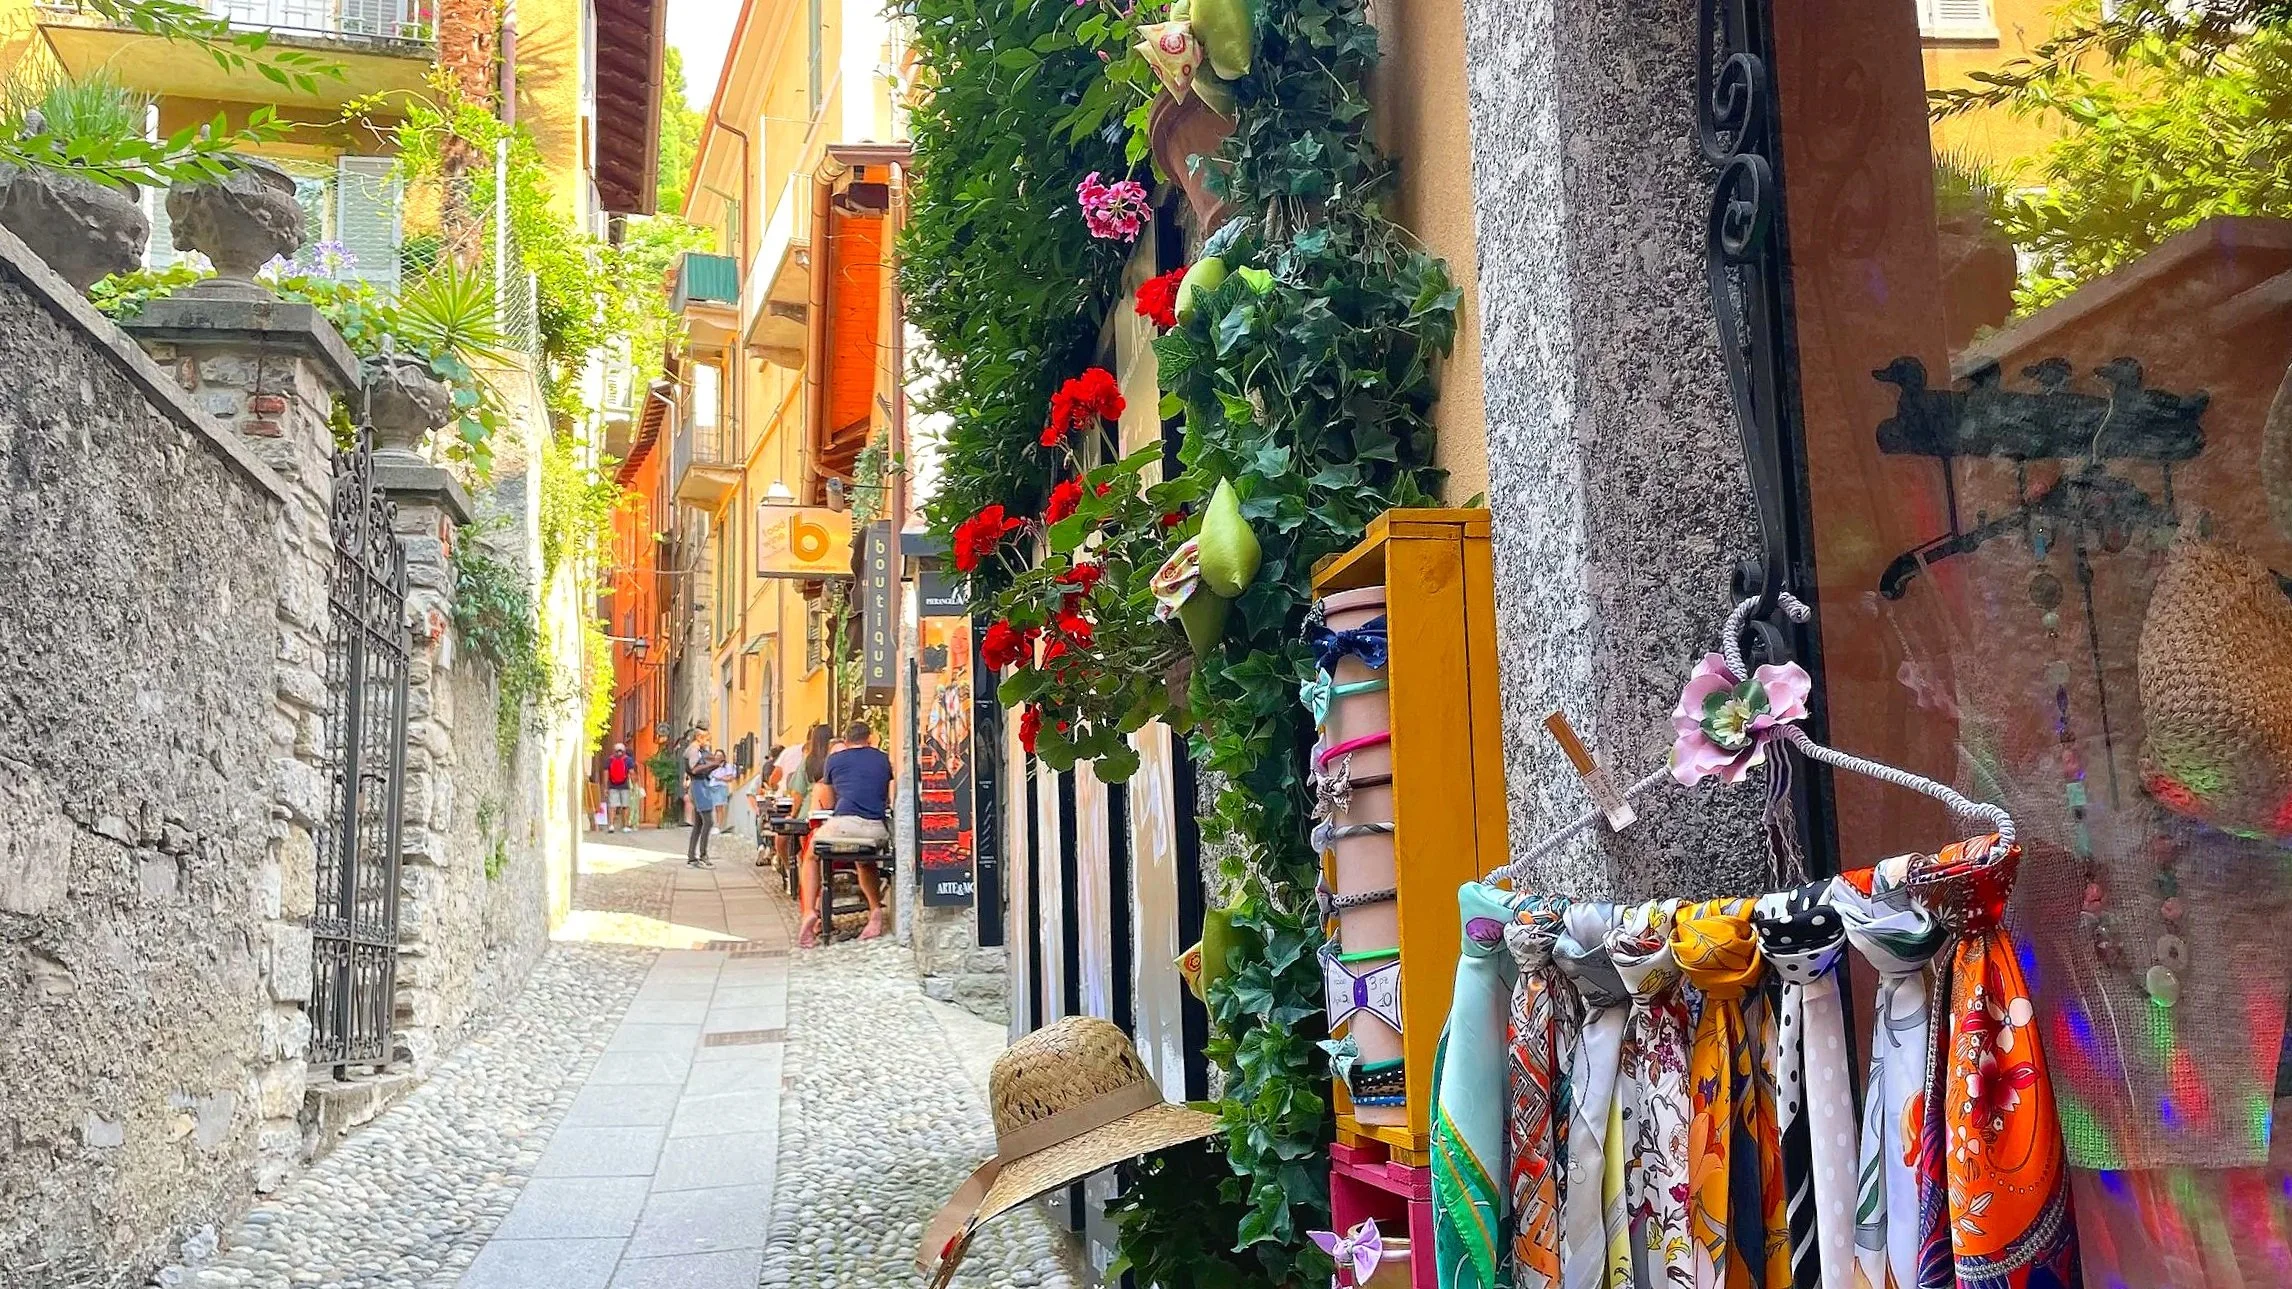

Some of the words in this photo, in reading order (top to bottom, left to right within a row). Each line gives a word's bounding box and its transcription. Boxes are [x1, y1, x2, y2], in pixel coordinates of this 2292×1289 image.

[791, 512, 831, 562] b
[873, 539, 886, 678] boutique
[1368, 975, 1377, 990] 3
